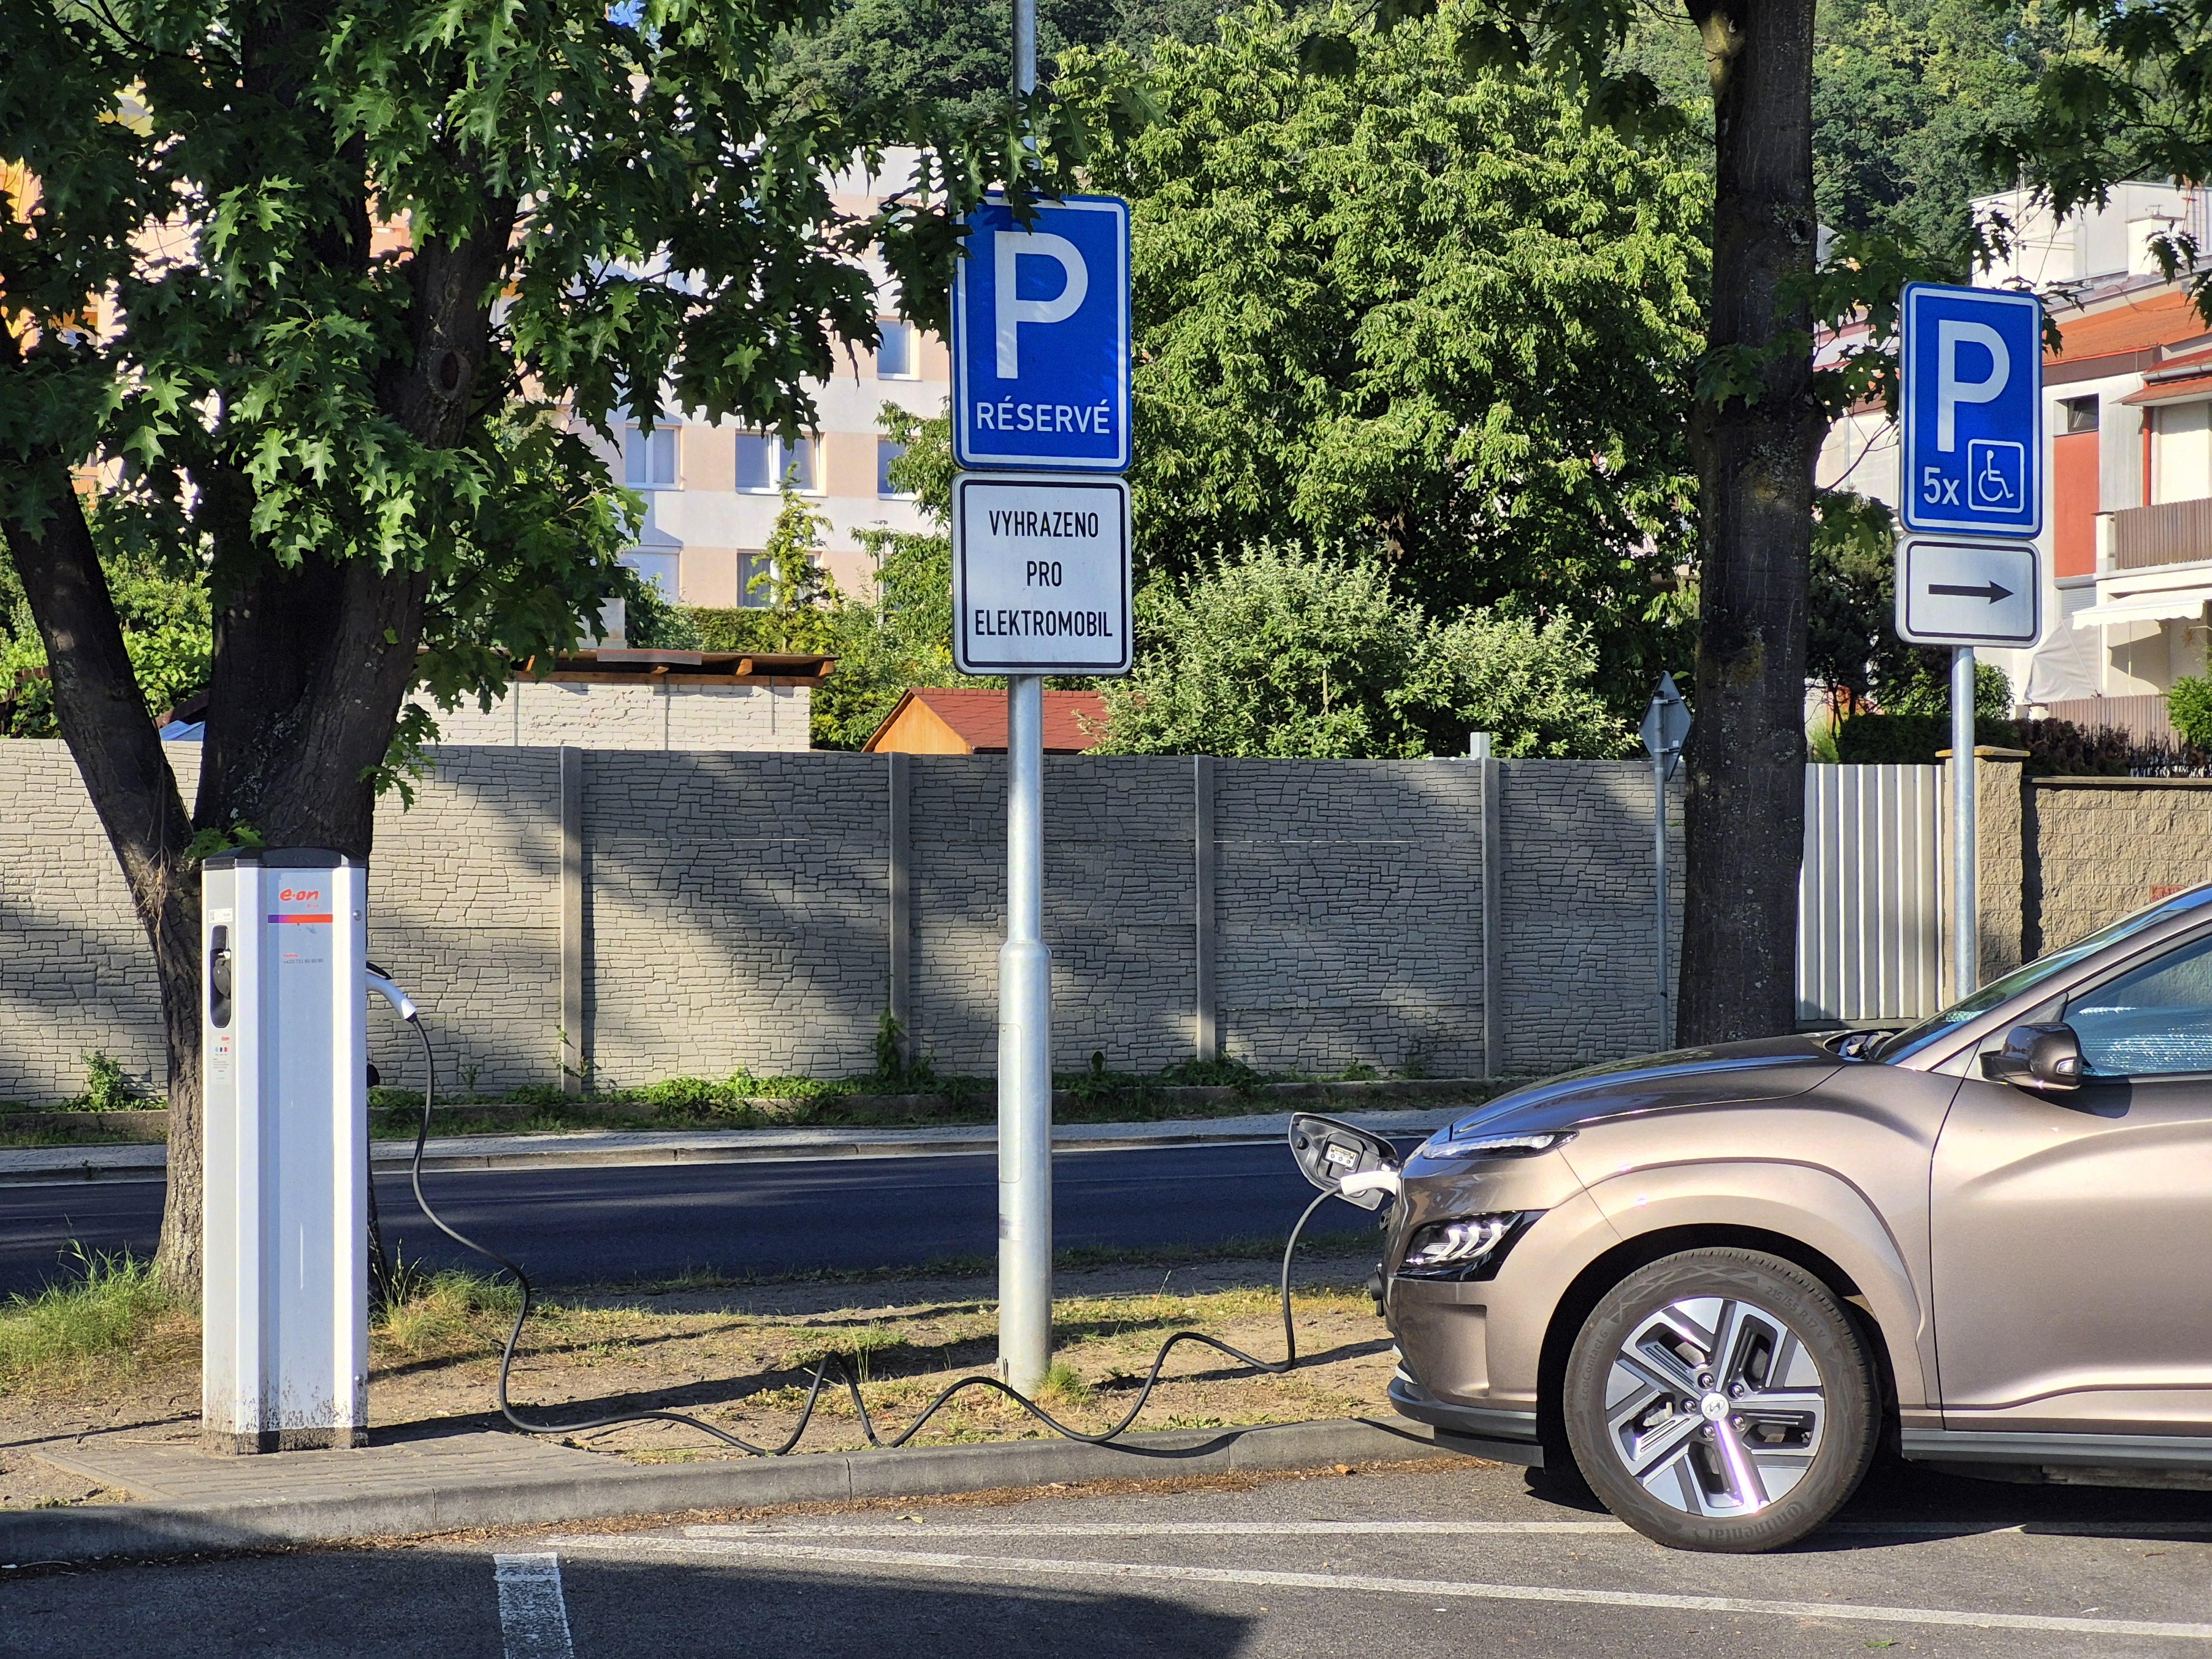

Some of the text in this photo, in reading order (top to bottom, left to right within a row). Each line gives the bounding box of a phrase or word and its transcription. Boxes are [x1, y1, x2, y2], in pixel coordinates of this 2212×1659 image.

[994, 231, 1088, 379] P
[1937, 319, 2010, 452] P
[977, 395, 1110, 434] RÉSERVÉ
[1924, 466, 1960, 506] 5x
[989, 510, 1099, 538] VYHRAZENO
[1026, 560, 1062, 587] PRO
[974, 609, 1113, 637] ELEKTROMOBIL
[1765, 1286, 1799, 1311] 215/55
[1800, 1310, 1808, 1321] R
[1806, 1317, 1818, 1328] 17
[1599, 1330, 1608, 1338] 6
